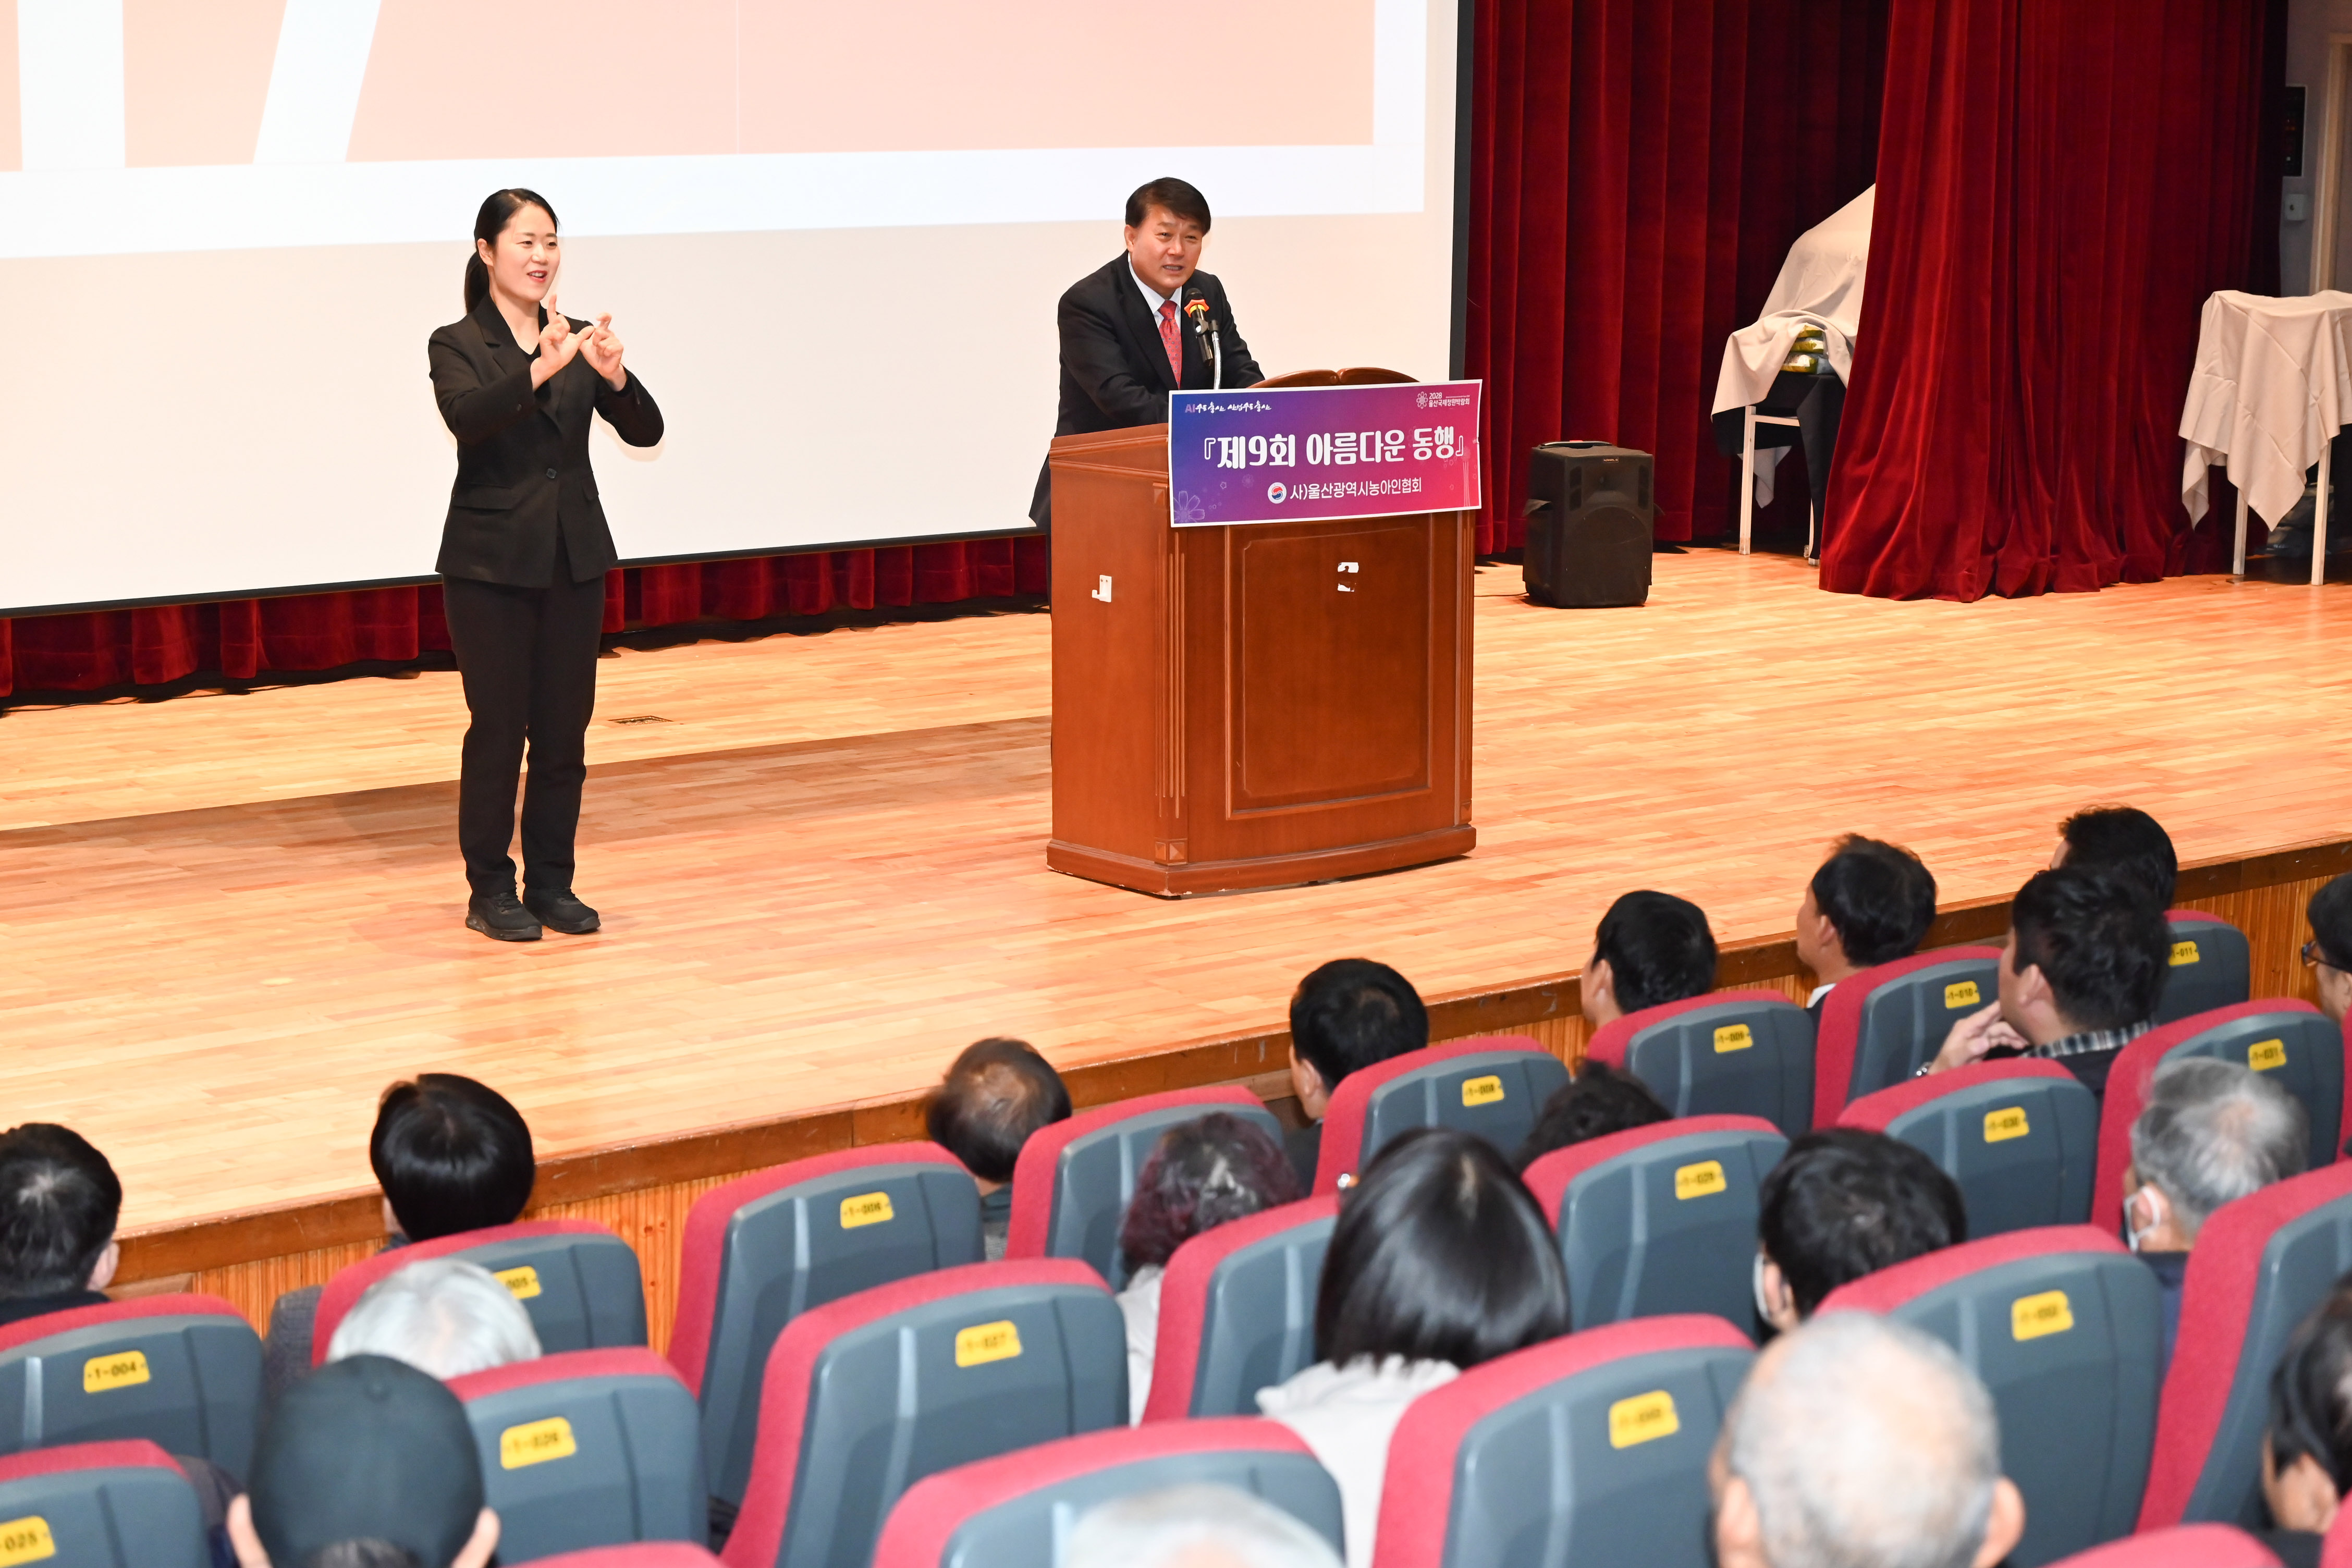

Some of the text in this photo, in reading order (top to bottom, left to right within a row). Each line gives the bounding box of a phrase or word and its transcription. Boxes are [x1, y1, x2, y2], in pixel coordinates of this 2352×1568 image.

[1429, 398, 1470, 407] 울산국제정원박람회
[1306, 429, 1406, 466] 아름다운
[95, 1361, 137, 1380] 1-004
